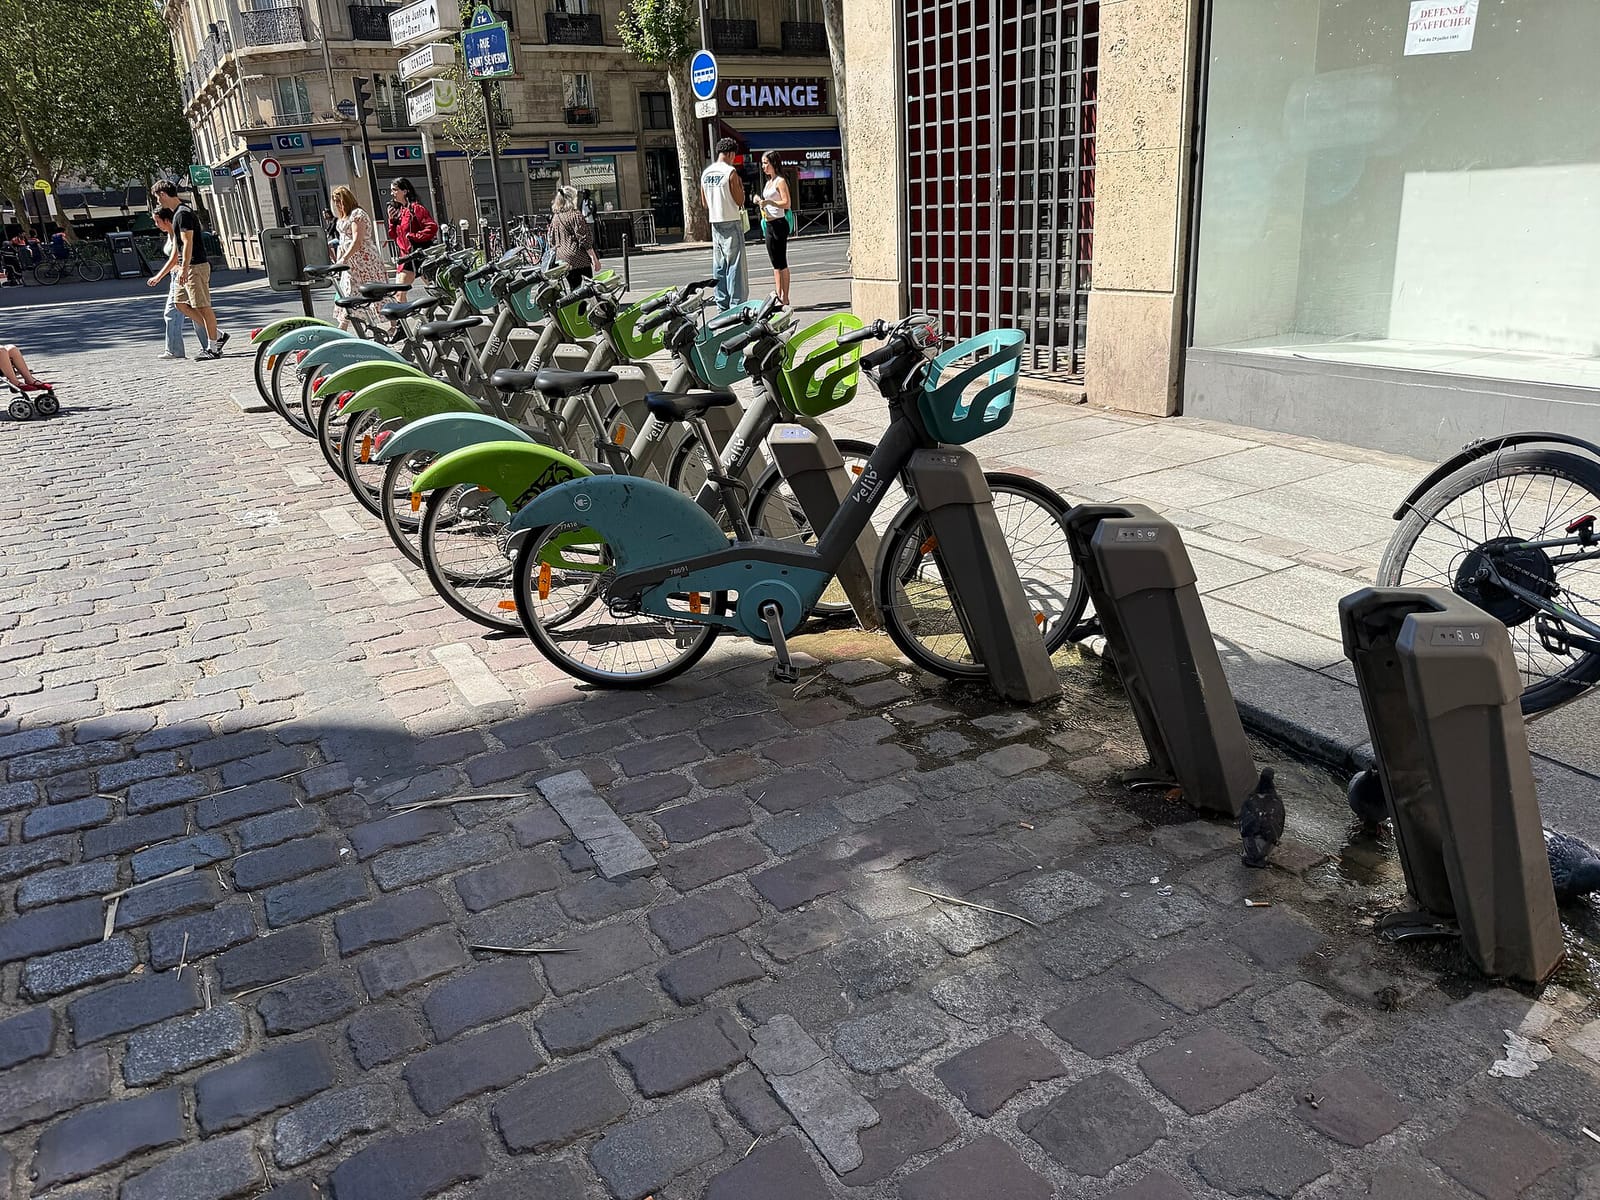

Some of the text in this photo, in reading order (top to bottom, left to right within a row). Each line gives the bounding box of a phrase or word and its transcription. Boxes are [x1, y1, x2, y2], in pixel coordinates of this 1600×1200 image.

[412, 7, 428, 21] Justice
[1410, 17, 1471, 31] D'AFFICHER
[394, 24, 421, 41] Notre-Dame
[479, 37, 491, 49] RUE
[411, 51, 432, 69] CONCORDE
[468, 56, 483, 67] SAINT
[725, 84, 819, 107] CHANGE
[279, 136, 303, 148] CIC
[557, 142, 577, 154] CIC
[396, 148, 420, 160] CIC
[805, 151, 831, 160] CHANGE
[214, 169, 228, 177] CIC
[1470, 632, 1480, 640] 10
